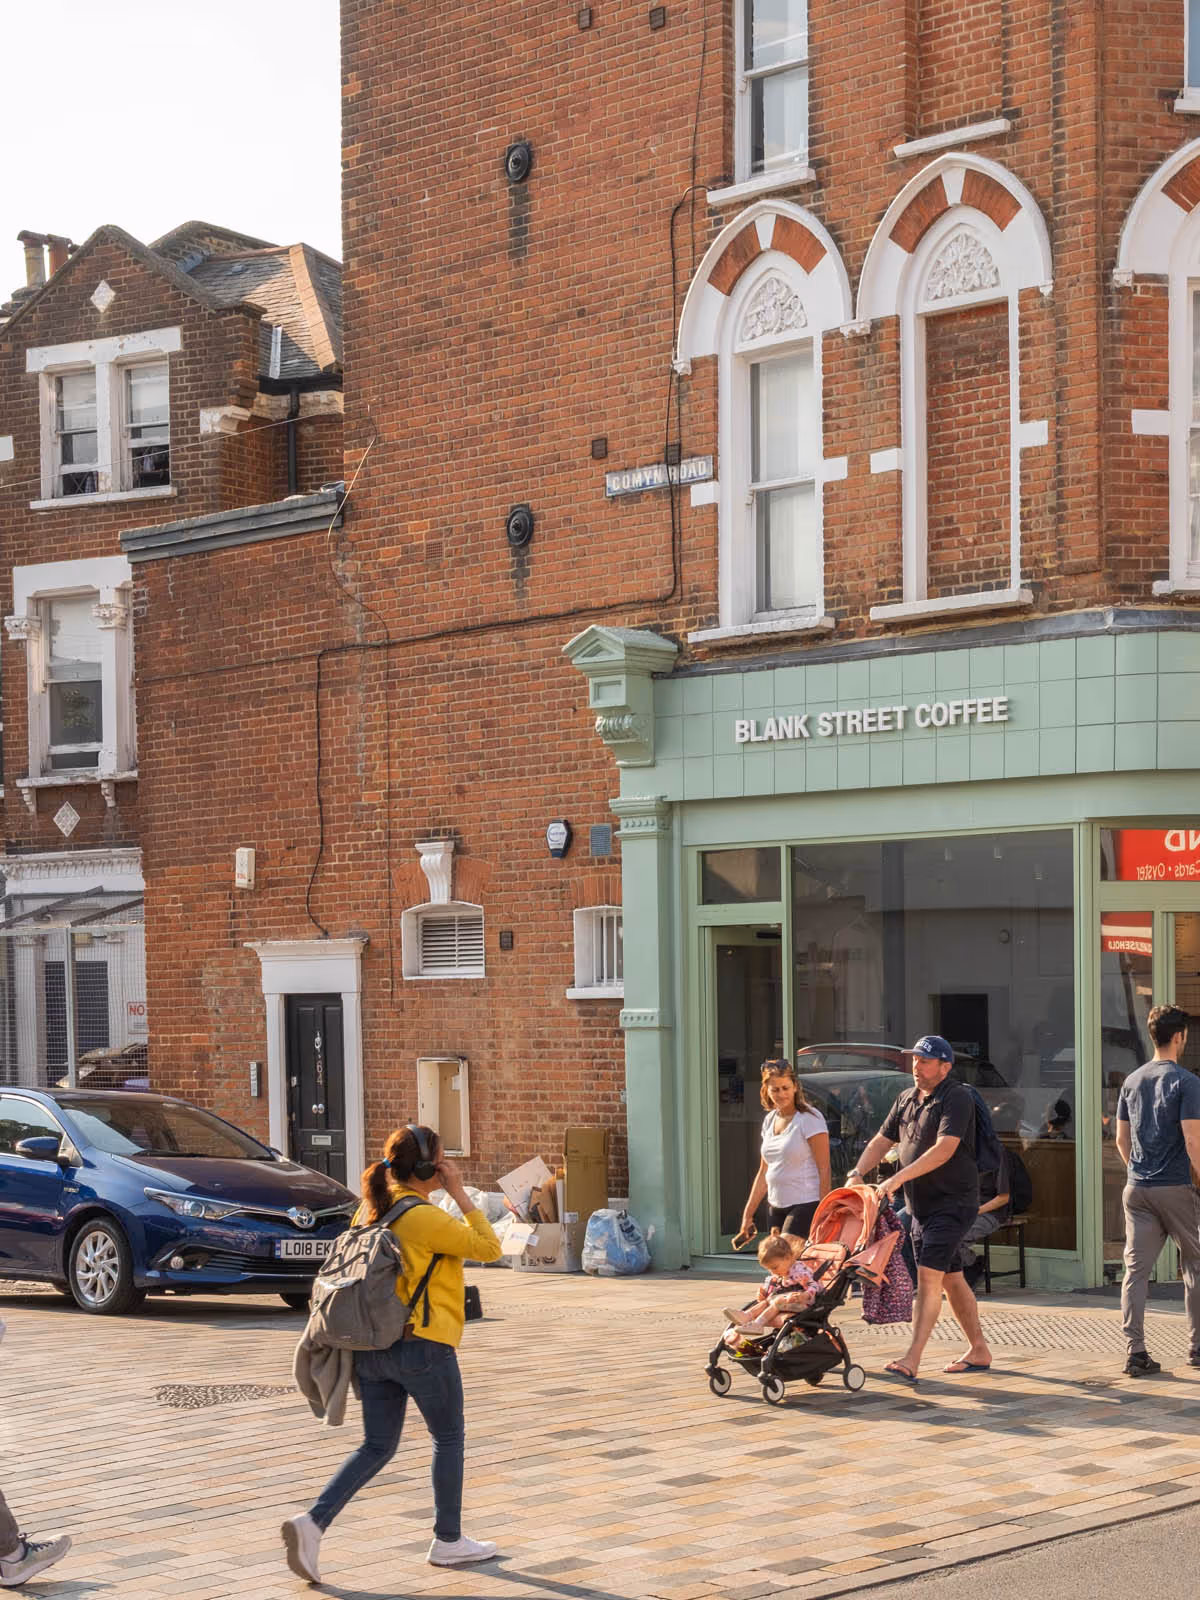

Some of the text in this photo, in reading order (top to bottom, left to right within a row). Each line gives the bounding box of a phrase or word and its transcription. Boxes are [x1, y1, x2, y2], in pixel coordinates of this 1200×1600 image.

[612, 461, 706, 491] COMYN ROAD
[735, 696, 1009, 743] BLANK STREET COFFEE
[130, 1004, 145, 1016] NO
[285, 1242, 331, 1256] LO18 EK
